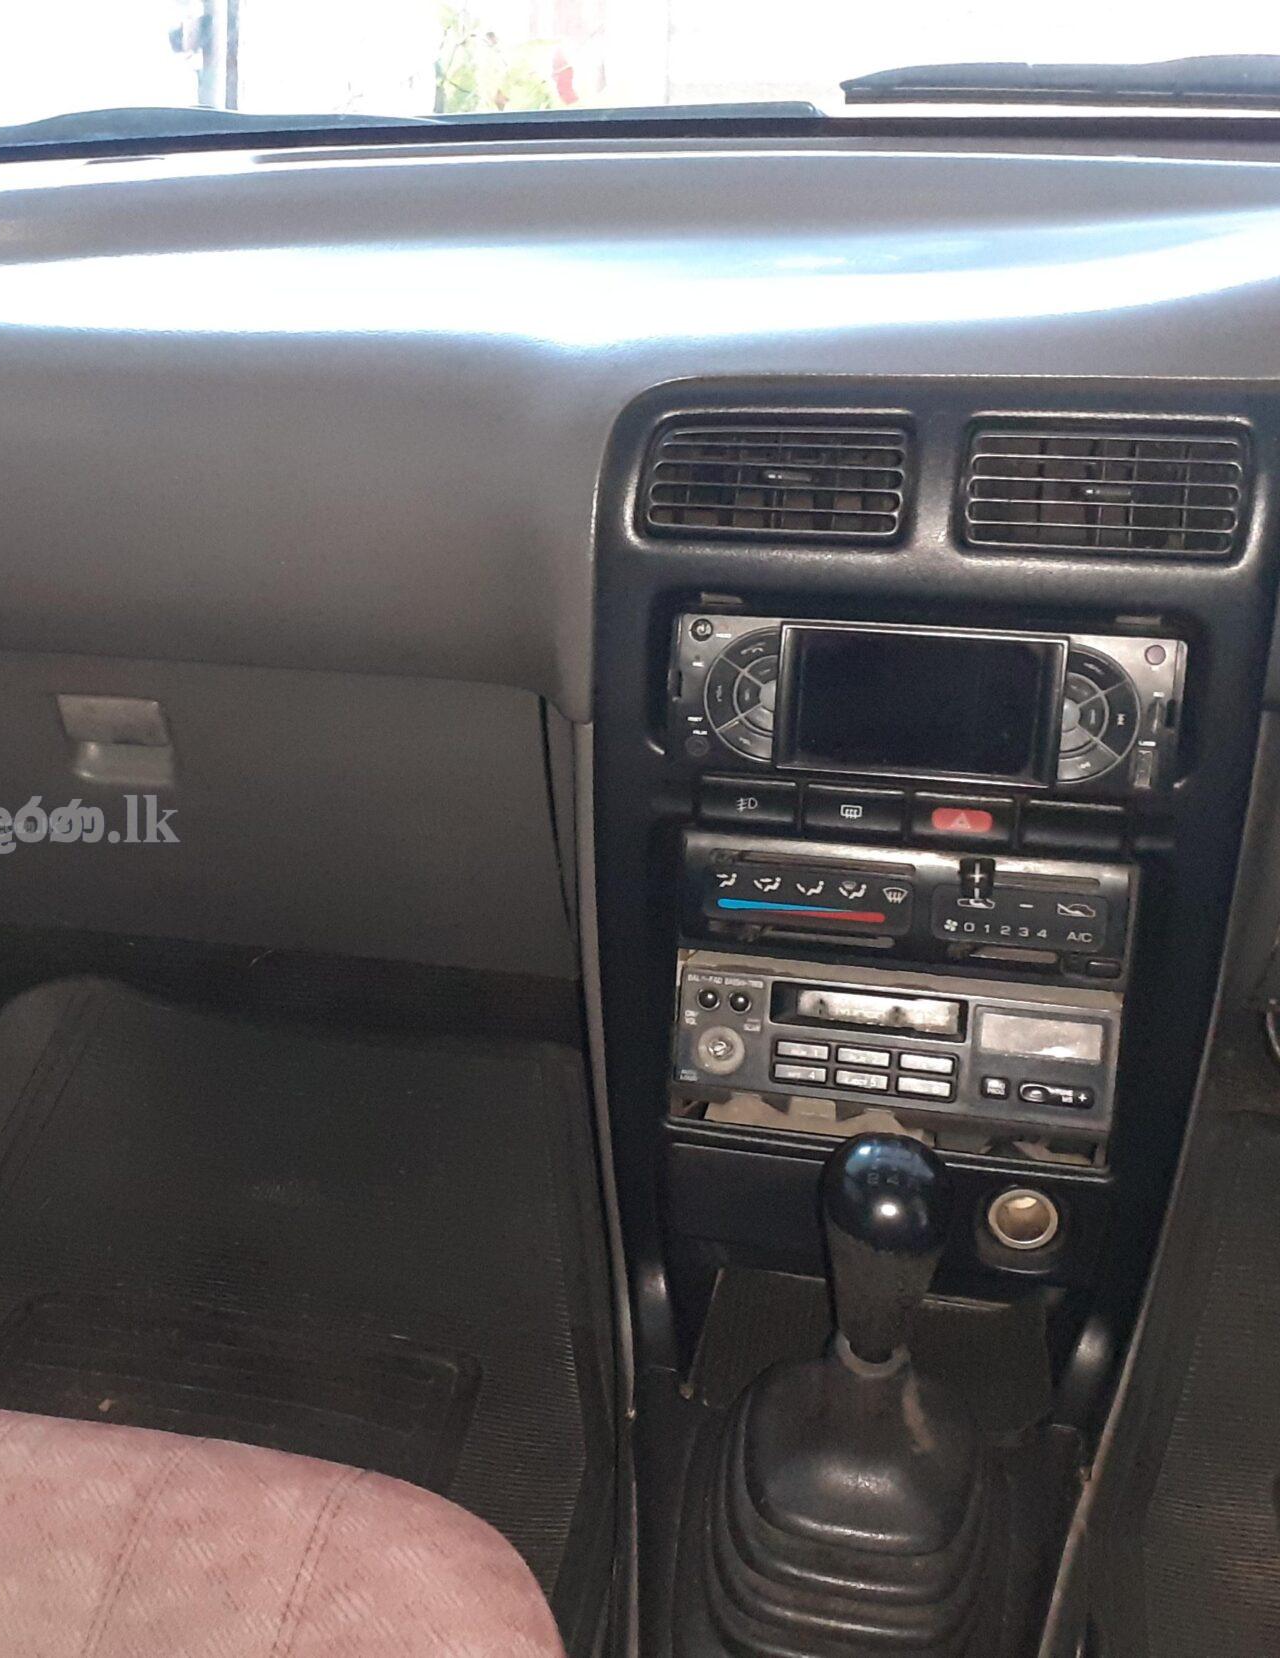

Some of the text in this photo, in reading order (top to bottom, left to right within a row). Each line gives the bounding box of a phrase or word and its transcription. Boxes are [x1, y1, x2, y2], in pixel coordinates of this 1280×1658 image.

[984, 924, 990, 934] 1
[1000, 925, 1011, 936] 2
[1019, 926, 1030, 938] 3
[1036, 929, 1047, 938] 4
[1066, 931, 1093, 943] A/C
